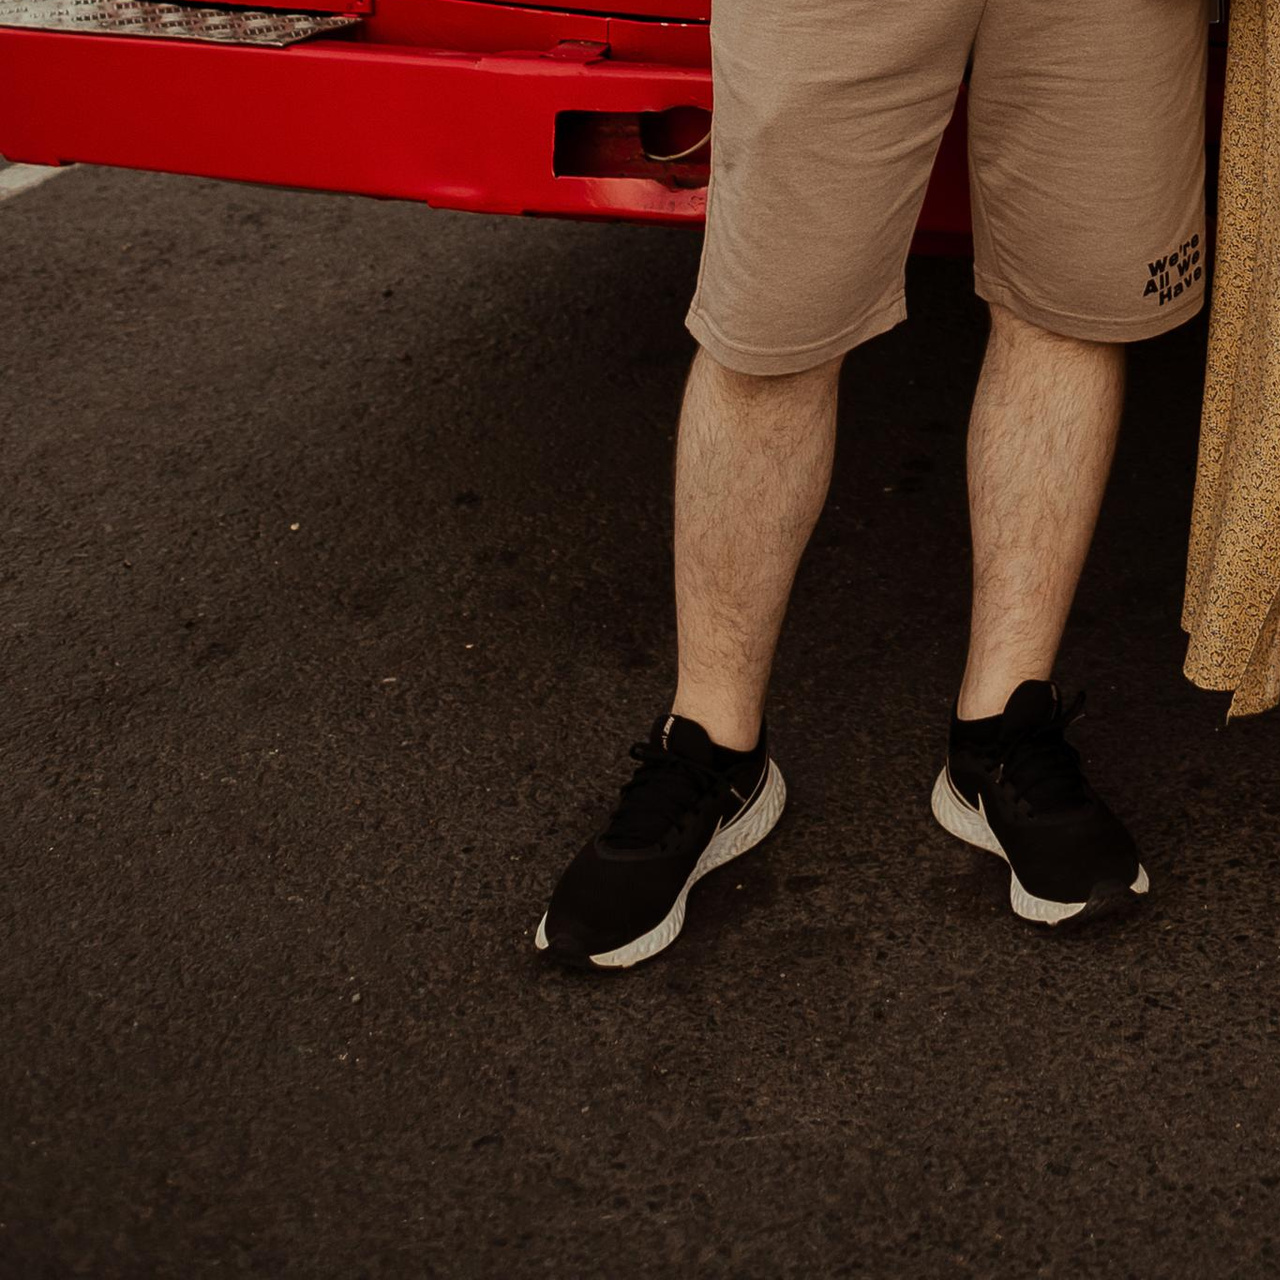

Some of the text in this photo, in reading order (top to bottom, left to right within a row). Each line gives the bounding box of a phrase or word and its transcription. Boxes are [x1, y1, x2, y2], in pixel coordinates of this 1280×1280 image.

[1143, 250, 1200, 298] All We
[1148, 233, 1199, 277] We're
[1159, 266, 1202, 307] Have
